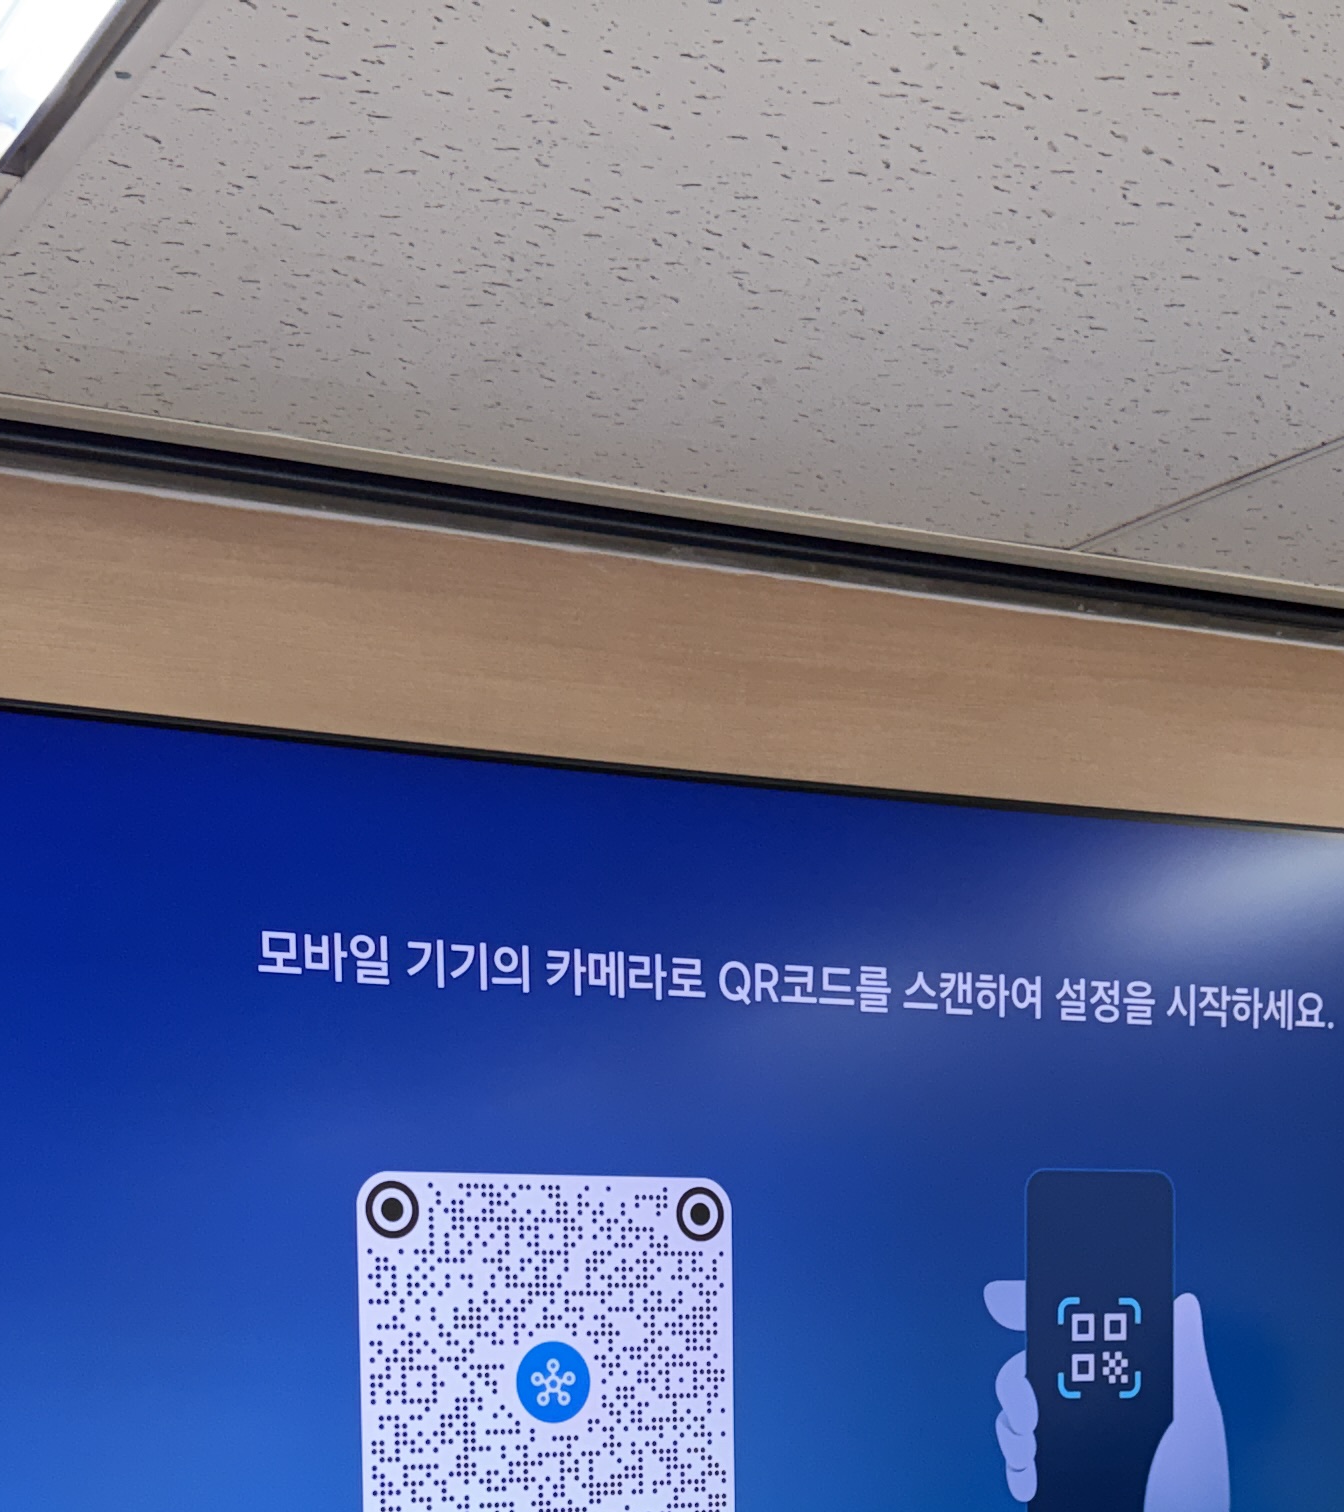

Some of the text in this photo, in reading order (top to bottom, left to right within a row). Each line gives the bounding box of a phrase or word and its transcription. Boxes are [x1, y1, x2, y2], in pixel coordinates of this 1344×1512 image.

[258, 930, 1335, 1031] 모바일 기기의 카메라로 QR코드를 스캔하여 설정을 시작하세요.
